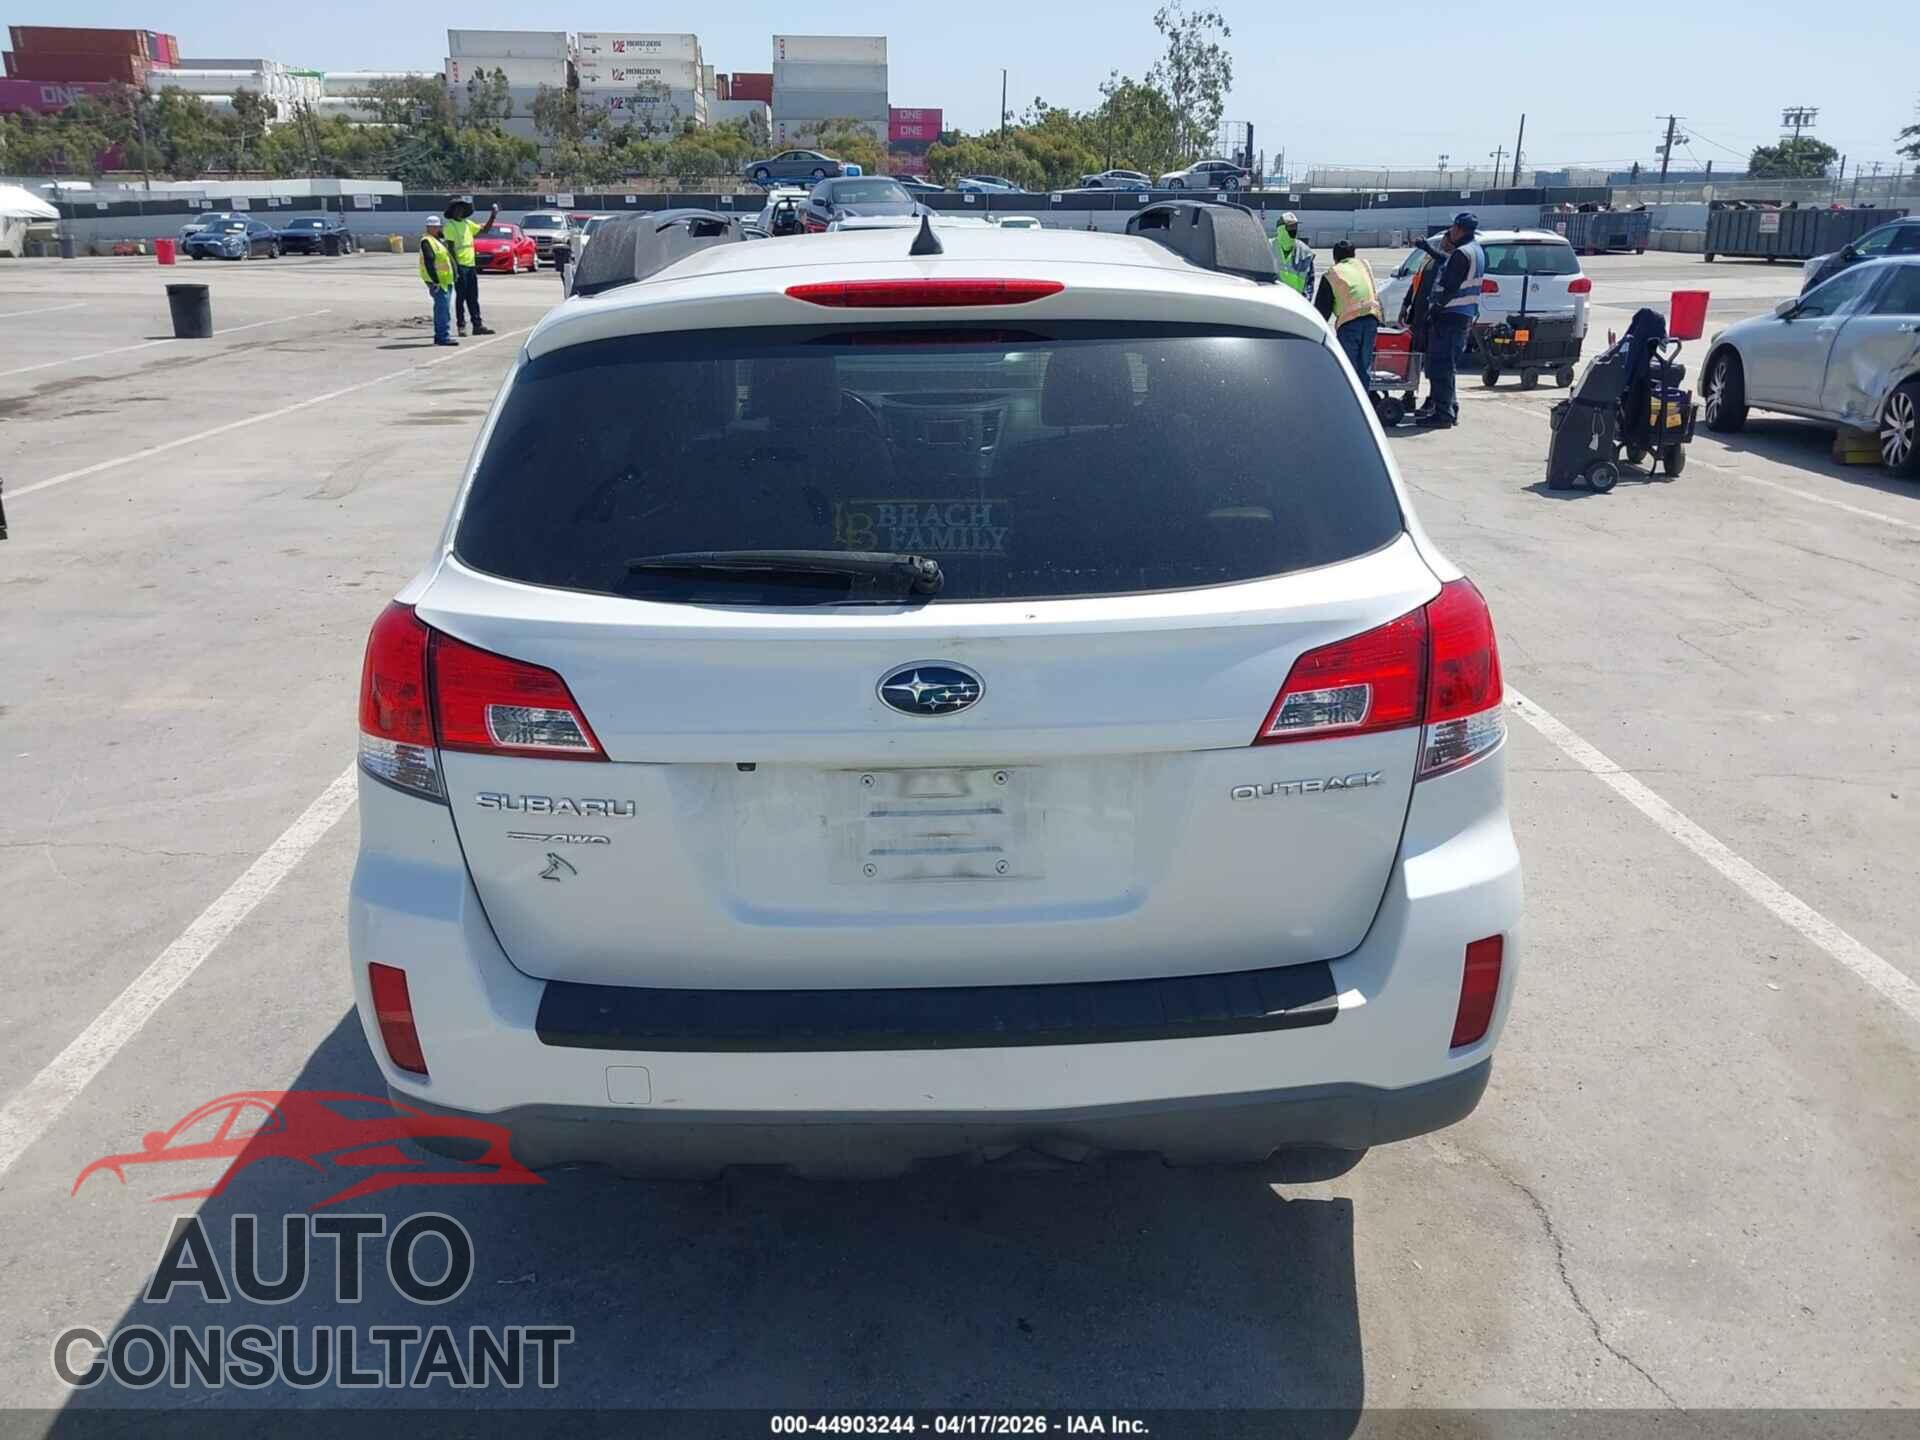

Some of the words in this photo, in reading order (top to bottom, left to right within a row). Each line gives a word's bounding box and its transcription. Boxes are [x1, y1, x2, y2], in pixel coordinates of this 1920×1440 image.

[878, 503, 994, 528] BEACH
[889, 527, 1009, 550] FAMILY
[1230, 769, 1386, 801] OUTBACK
[475, 791, 636, 818] SUBARU
